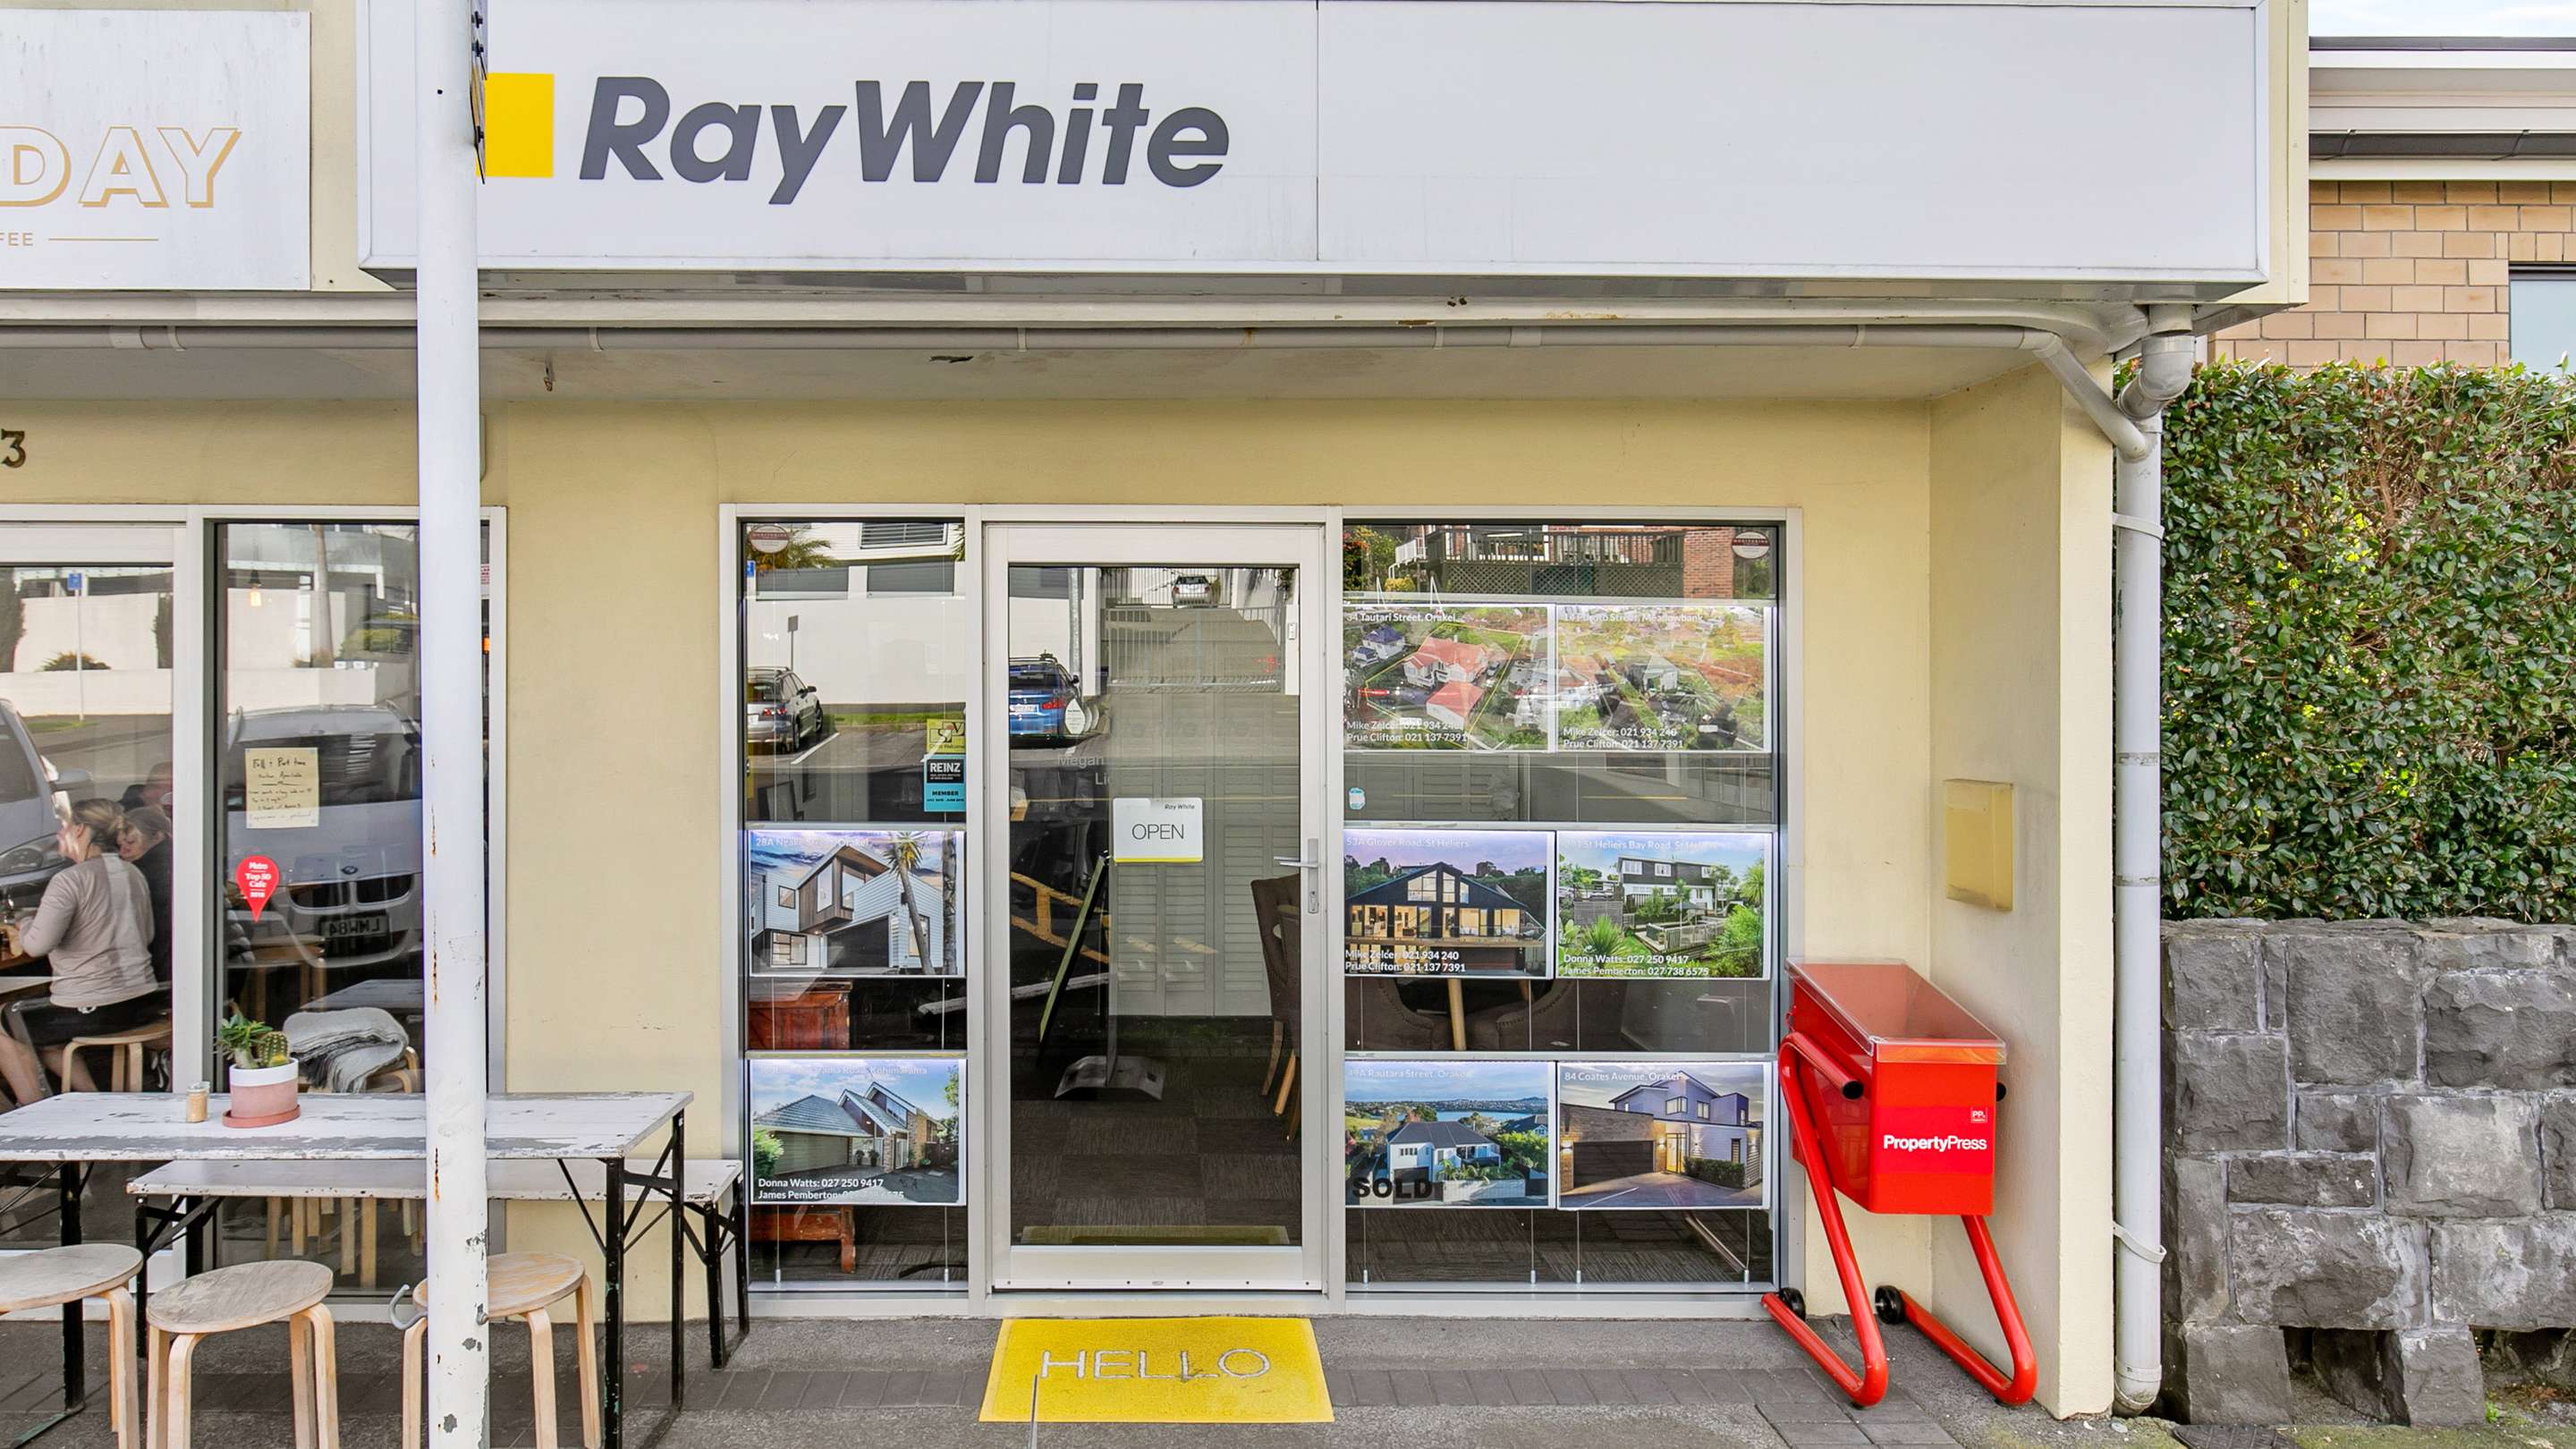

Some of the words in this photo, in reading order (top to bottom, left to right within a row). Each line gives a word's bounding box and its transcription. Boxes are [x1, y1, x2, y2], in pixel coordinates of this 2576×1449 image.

[1346, 721, 1368, 729] Mike
[1424, 721, 1441, 730] 934
[1563, 728, 1586, 736] Mike
[1621, 728, 1638, 736] 021
[1640, 728, 1657, 736] 934
[1659, 728, 1677, 737] 240
[1346, 733, 1368, 741] Prue
[1405, 733, 1422, 741] 021
[1425, 733, 1442, 742] 137
[1444, 733, 1467, 742] 7391
[1563, 740, 1584, 748] Prue
[1622, 740, 1639, 748] 021
[1641, 740, 1657, 749] 137
[1660, 740, 1683, 749] 7391
[930, 762, 961, 773] REINZ
[1131, 823, 1184, 840] OPEN
[1595, 841, 1626, 849] Heliers
[1629, 841, 1646, 851] Bay
[244, 873, 260, 881] Top
[1422, 951, 1439, 960] 934
[1441, 951, 1460, 961] 240
[1563, 954, 1593, 963] Donna
[1627, 954, 1645, 963] 027
[1647, 954, 1664, 963] 250
[1666, 954, 1690, 963] 9417
[1345, 962, 1367, 970] Prue
[1403, 963, 1420, 971] 021
[1423, 963, 1441, 971] 137
[1442, 963, 1466, 972] 7391
[1563, 967, 1591, 976] James
[1648, 967, 1665, 975] 027
[1667, 967, 1684, 976] 738
[1564, 1072, 1576, 1080] 84
[1578, 1072, 1609, 1080] Coates
[1611, 1072, 1648, 1081] Avenue,
[1883, 1135, 1987, 1152] PropertyPress
[758, 1178, 788, 1187] Donna
[790, 1178, 820, 1187] Watts:
[822, 1178, 839, 1187] 027
[841, 1178, 859, 1187] 250
[860, 1178, 884, 1187] 9417
[1352, 1177, 1432, 1198] SOLD
[758, 1191, 786, 1199] James
[1041, 1348, 1271, 1380] HELLO
